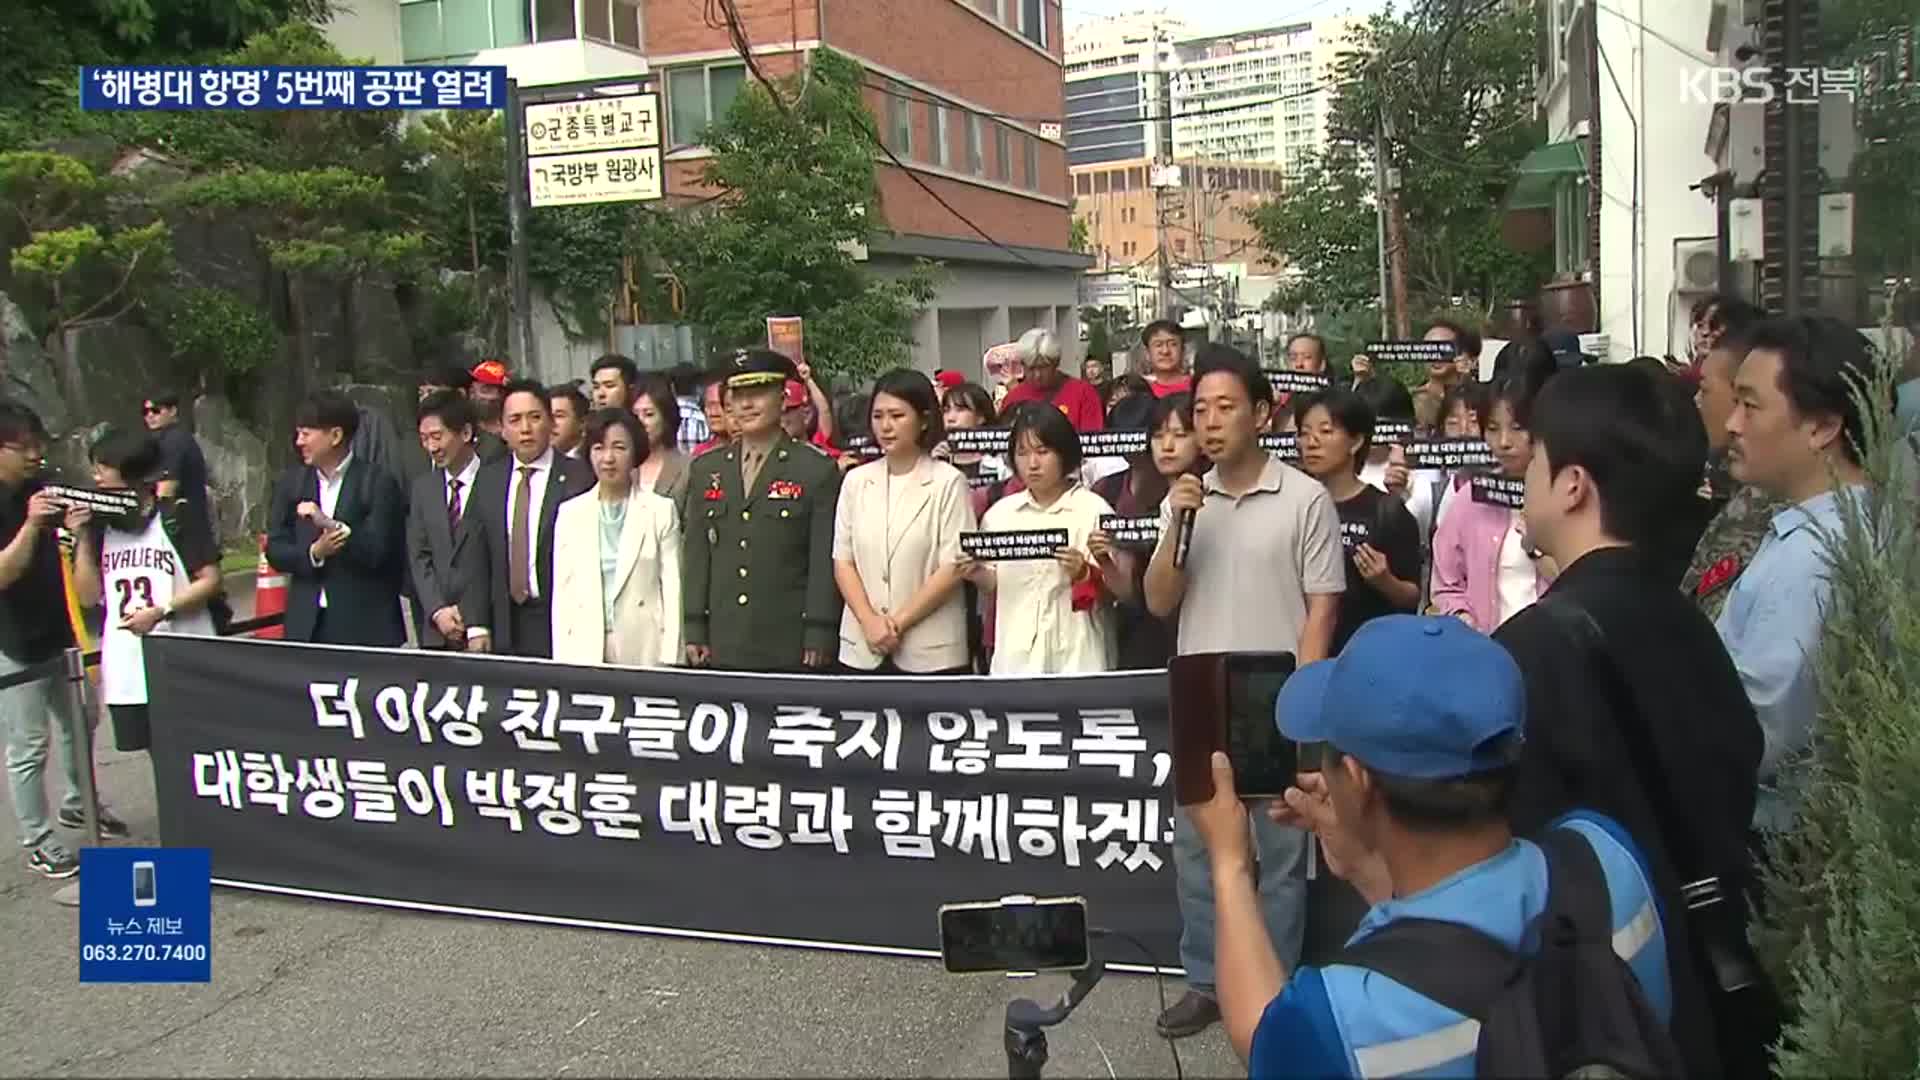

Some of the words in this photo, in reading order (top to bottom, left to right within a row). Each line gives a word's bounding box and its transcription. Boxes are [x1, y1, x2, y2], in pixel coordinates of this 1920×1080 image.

[548, 110, 652, 142] 군종특별교구
[551, 161, 600, 187] 국방부
[605, 156, 655, 183] 원광사
[308, 678, 365, 739] 더
[375, 682, 488, 747] 이상
[500, 689, 746, 760] 친구들이
[767, 704, 900, 771] 죽지
[926, 707, 1172, 787] 않도록,
[192, 750, 455, 827] 대학생들이
[465, 767, 643, 840] 박정훈
[659, 780, 853, 854] 대령과
[872, 789, 1176, 873] 함께하겠
